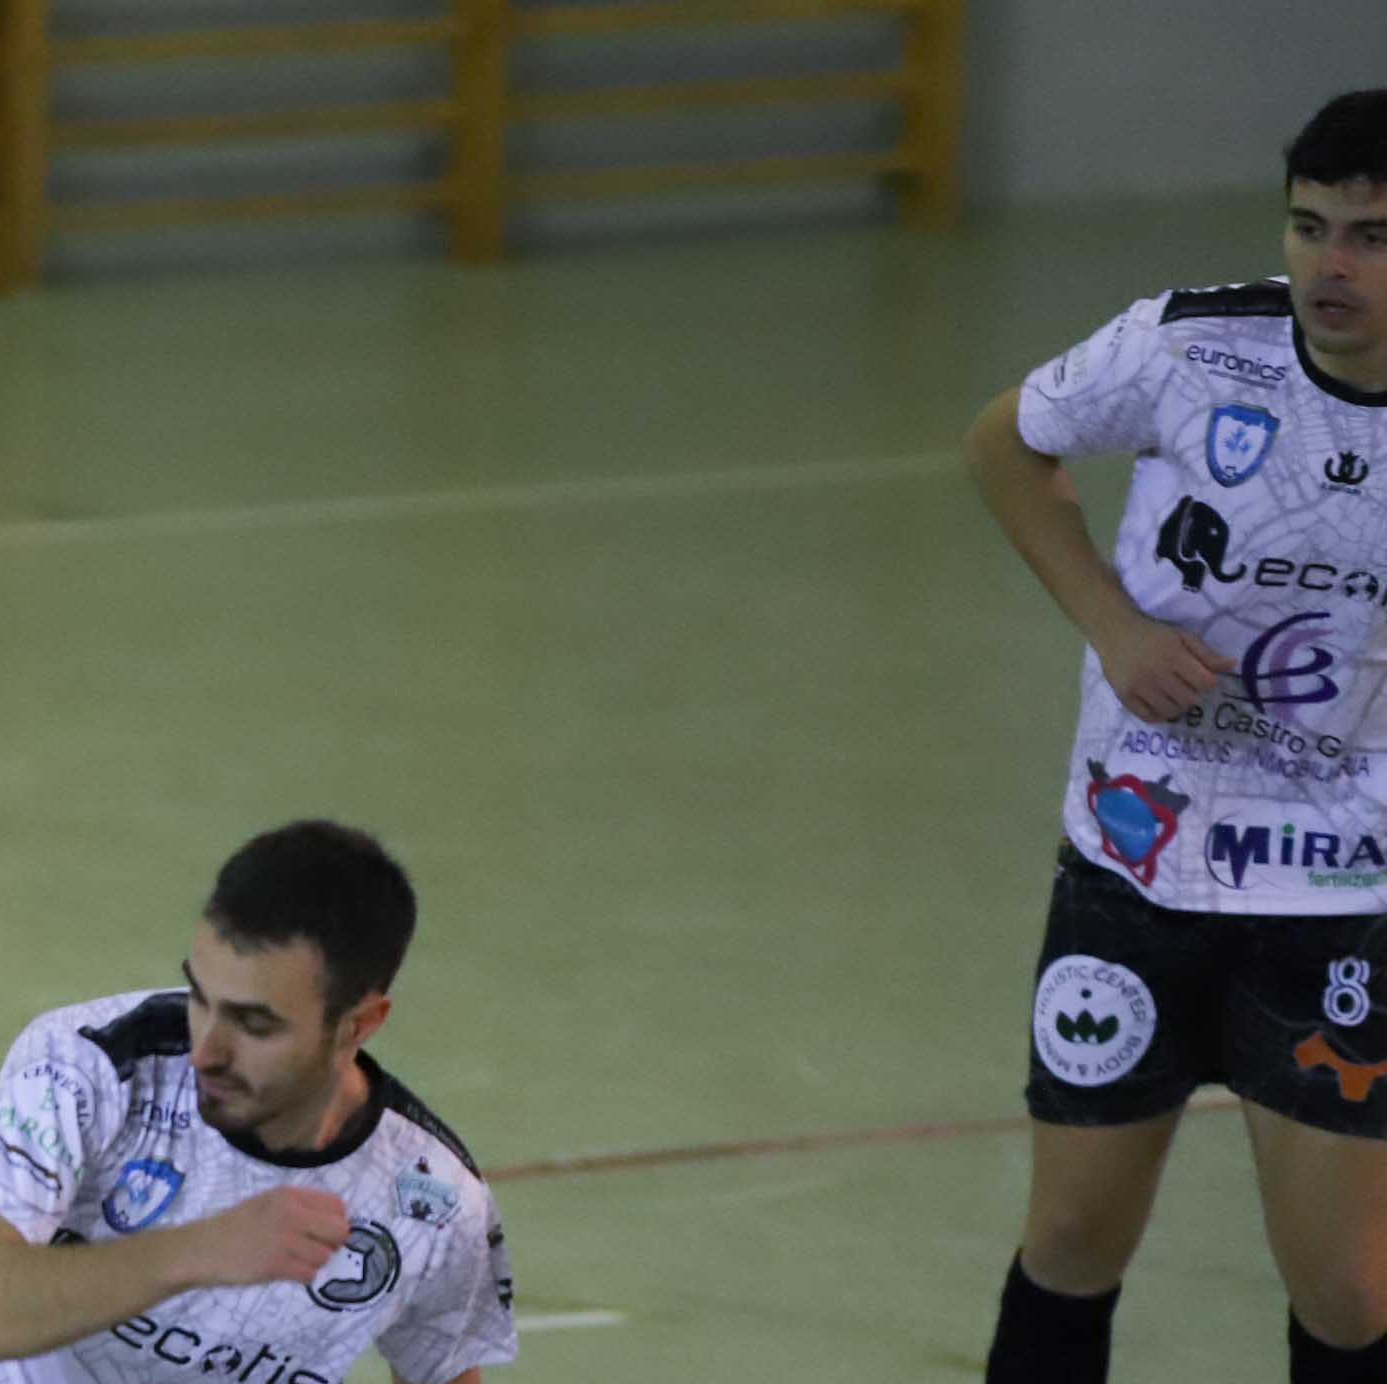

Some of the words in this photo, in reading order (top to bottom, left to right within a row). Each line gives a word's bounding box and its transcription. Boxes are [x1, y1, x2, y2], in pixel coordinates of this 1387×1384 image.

[1186, 344, 1287, 382] euronics
[1120, 730, 1235, 764] ABOGADOS
[1213, 702, 1307, 754] Castro
[1324, 955, 1371, 1026] 8
[1096, 1035, 1142, 1077] BODY
